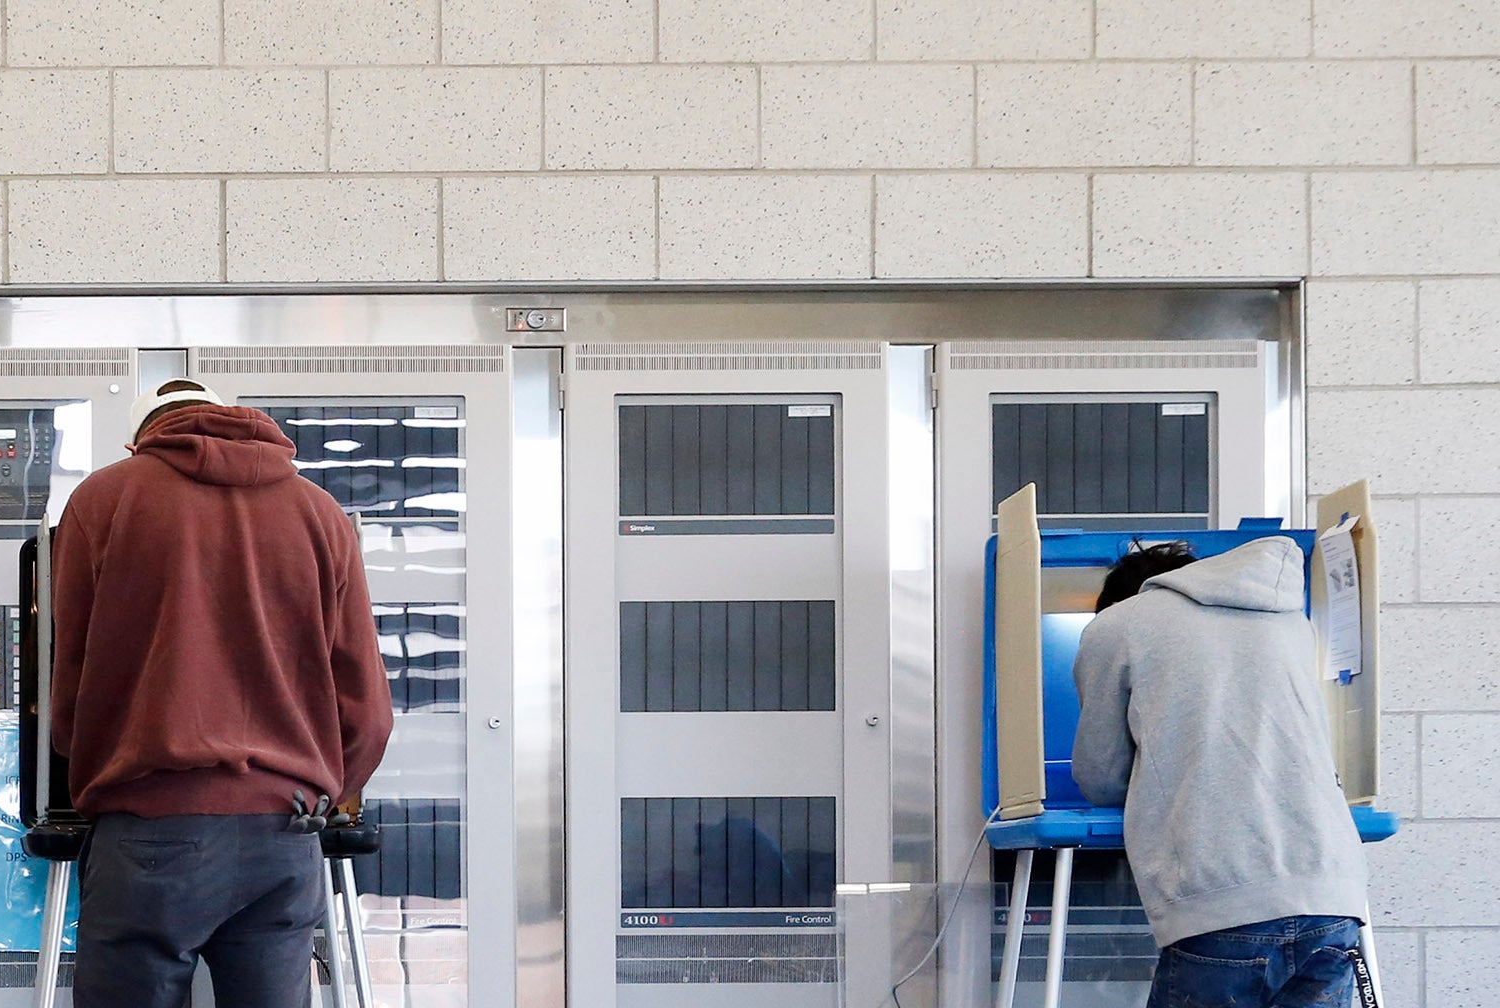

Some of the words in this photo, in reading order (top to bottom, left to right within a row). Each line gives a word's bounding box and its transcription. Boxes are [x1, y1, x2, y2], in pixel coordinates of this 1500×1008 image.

[629, 524, 655, 533] Simplex
[785, 915, 800, 923] Fire
[802, 915, 832, 923] Control
[1355, 958, 1370, 979] NOT
